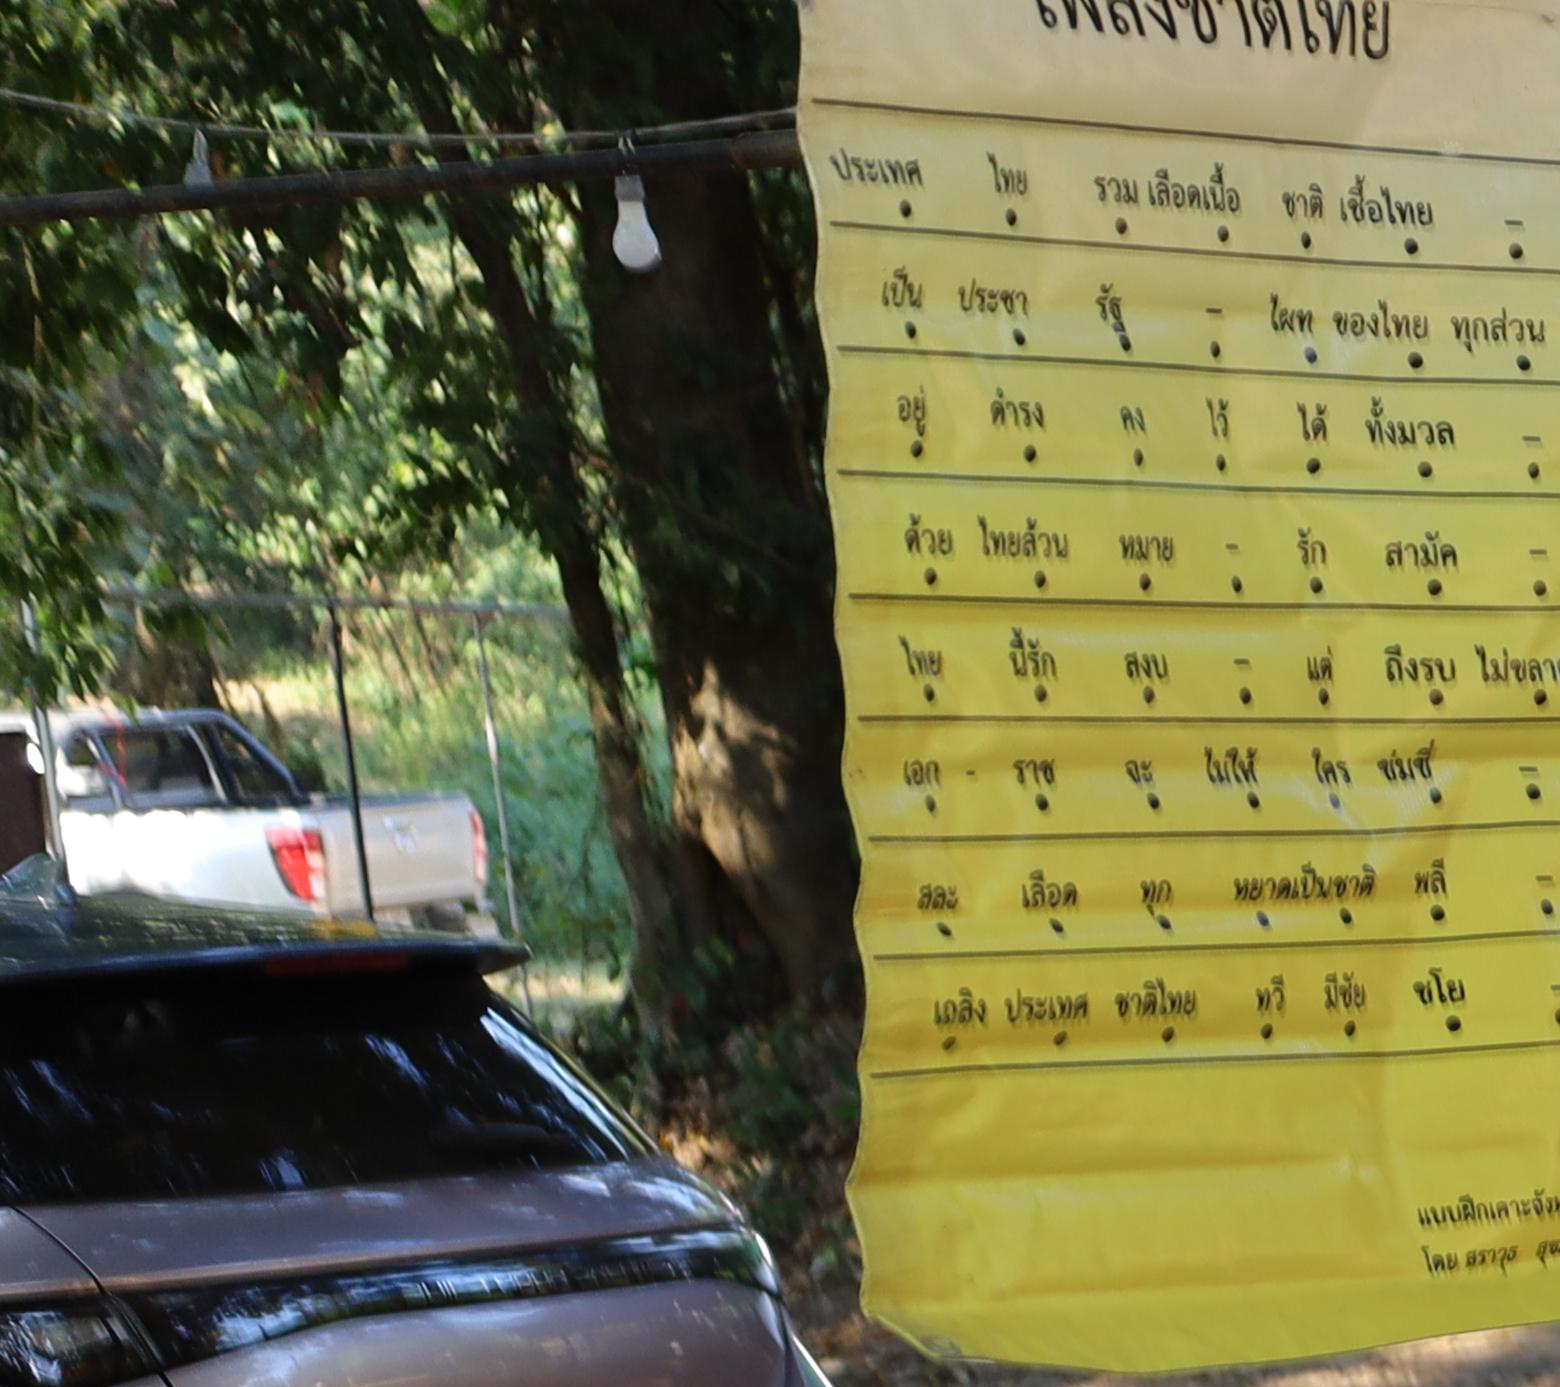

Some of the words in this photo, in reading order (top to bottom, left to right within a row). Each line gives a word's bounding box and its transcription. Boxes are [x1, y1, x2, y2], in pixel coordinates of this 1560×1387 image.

[828, 148, 924, 187] ประเทศ
[986, 151, 1029, 197] ไทย
[1281, 182, 1324, 219] ชาติ
[1340, 174, 1434, 227] เชื้อไทย
[881, 265, 923, 310] เป็น
[957, 278, 1029, 317] ประชา
[1095, 283, 1127, 334] รัฐ
[1332, 299, 1429, 341] ของไทย
[1450, 307, 1546, 354] ทุกส่วน
[897, 385, 928, 438] อยู่
[990, 387, 1045, 429] ดำรง
[1119, 406, 1147, 434] คง
[1205, 398, 1230, 441] ไว้
[1296, 402, 1328, 442] ได้
[1364, 396, 1456, 447] ทั้งมวล
[904, 513, 954, 557] ด้วย
[977, 515, 1069, 560] ไทยล้วน
[1118, 535, 1175, 564] หมาย
[1297, 527, 1327, 567] รัก
[1385, 531, 1458, 569] สามัค
[898, 635, 943, 678] ไทย
[1008, 626, 1058, 680] นี้รัก
[1124, 651, 1169, 681] สงบ
[1306, 645, 1334, 683] แต่
[1384, 644, 1457, 683] ถึงรบ
[903, 759, 942, 787] เอก
[1012, 758, 1056, 786] ราช
[1124, 759, 1154, 785] จะ
[1204, 746, 1258, 785] ไม่ให้
[1311, 747, 1352, 786] ใคร
[916, 883, 959, 914] สละ
[1021, 869, 1080, 913] เลือด
[1140, 879, 1174, 921] ทุก
[1414, 857, 1447, 896] พลี
[1004, 988, 1090, 1027] ประเทศ
[1114, 977, 1197, 1021] ชาติไทย
[1255, 974, 1286, 1017] ทวี
[1324, 971, 1367, 1013] มีชัย
[1413, 967, 1466, 1006] ชโย
[1421, 1245, 1458, 1273] โดย
